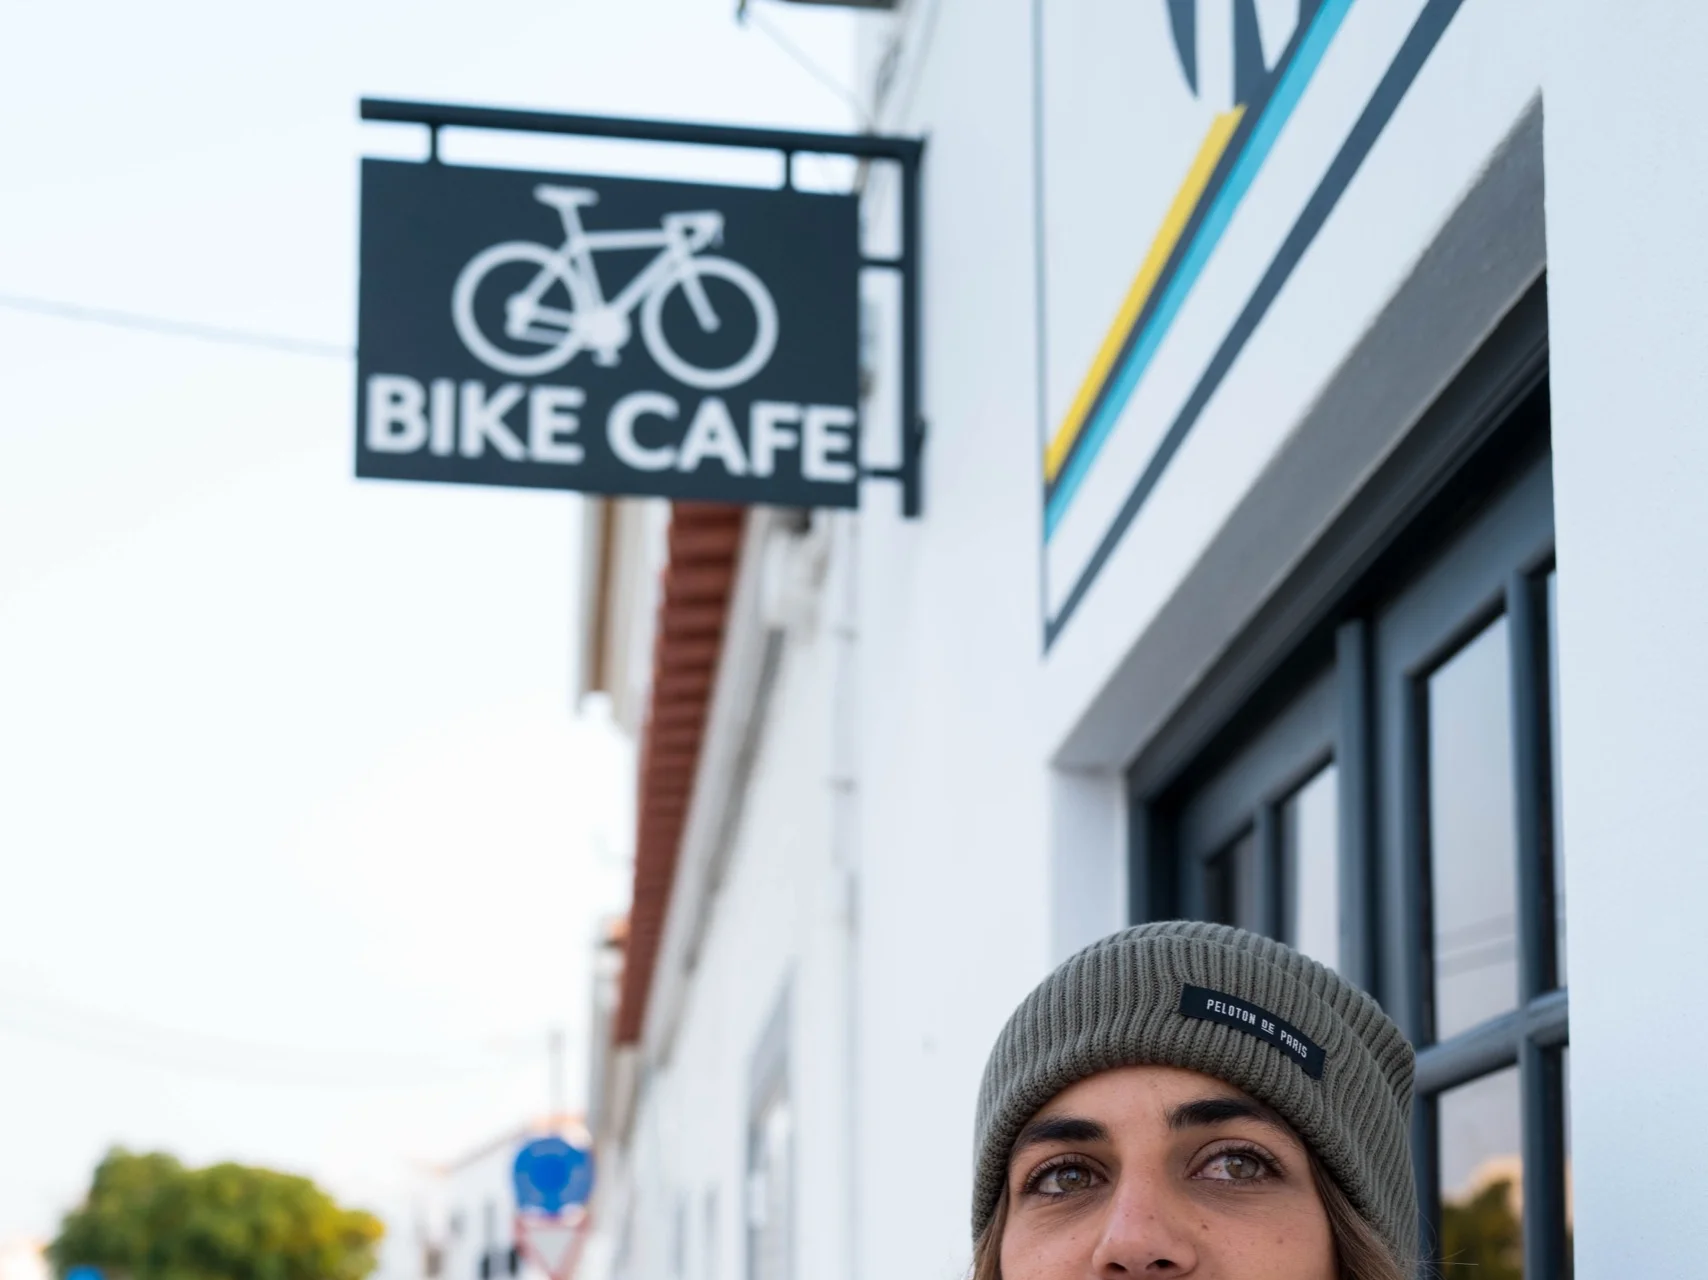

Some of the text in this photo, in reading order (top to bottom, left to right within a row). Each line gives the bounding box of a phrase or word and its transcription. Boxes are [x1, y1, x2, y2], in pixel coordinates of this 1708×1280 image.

[364, 373, 857, 482] BIKE CAFE
[1206, 999, 1308, 1059] PELOTON DE PARIS
